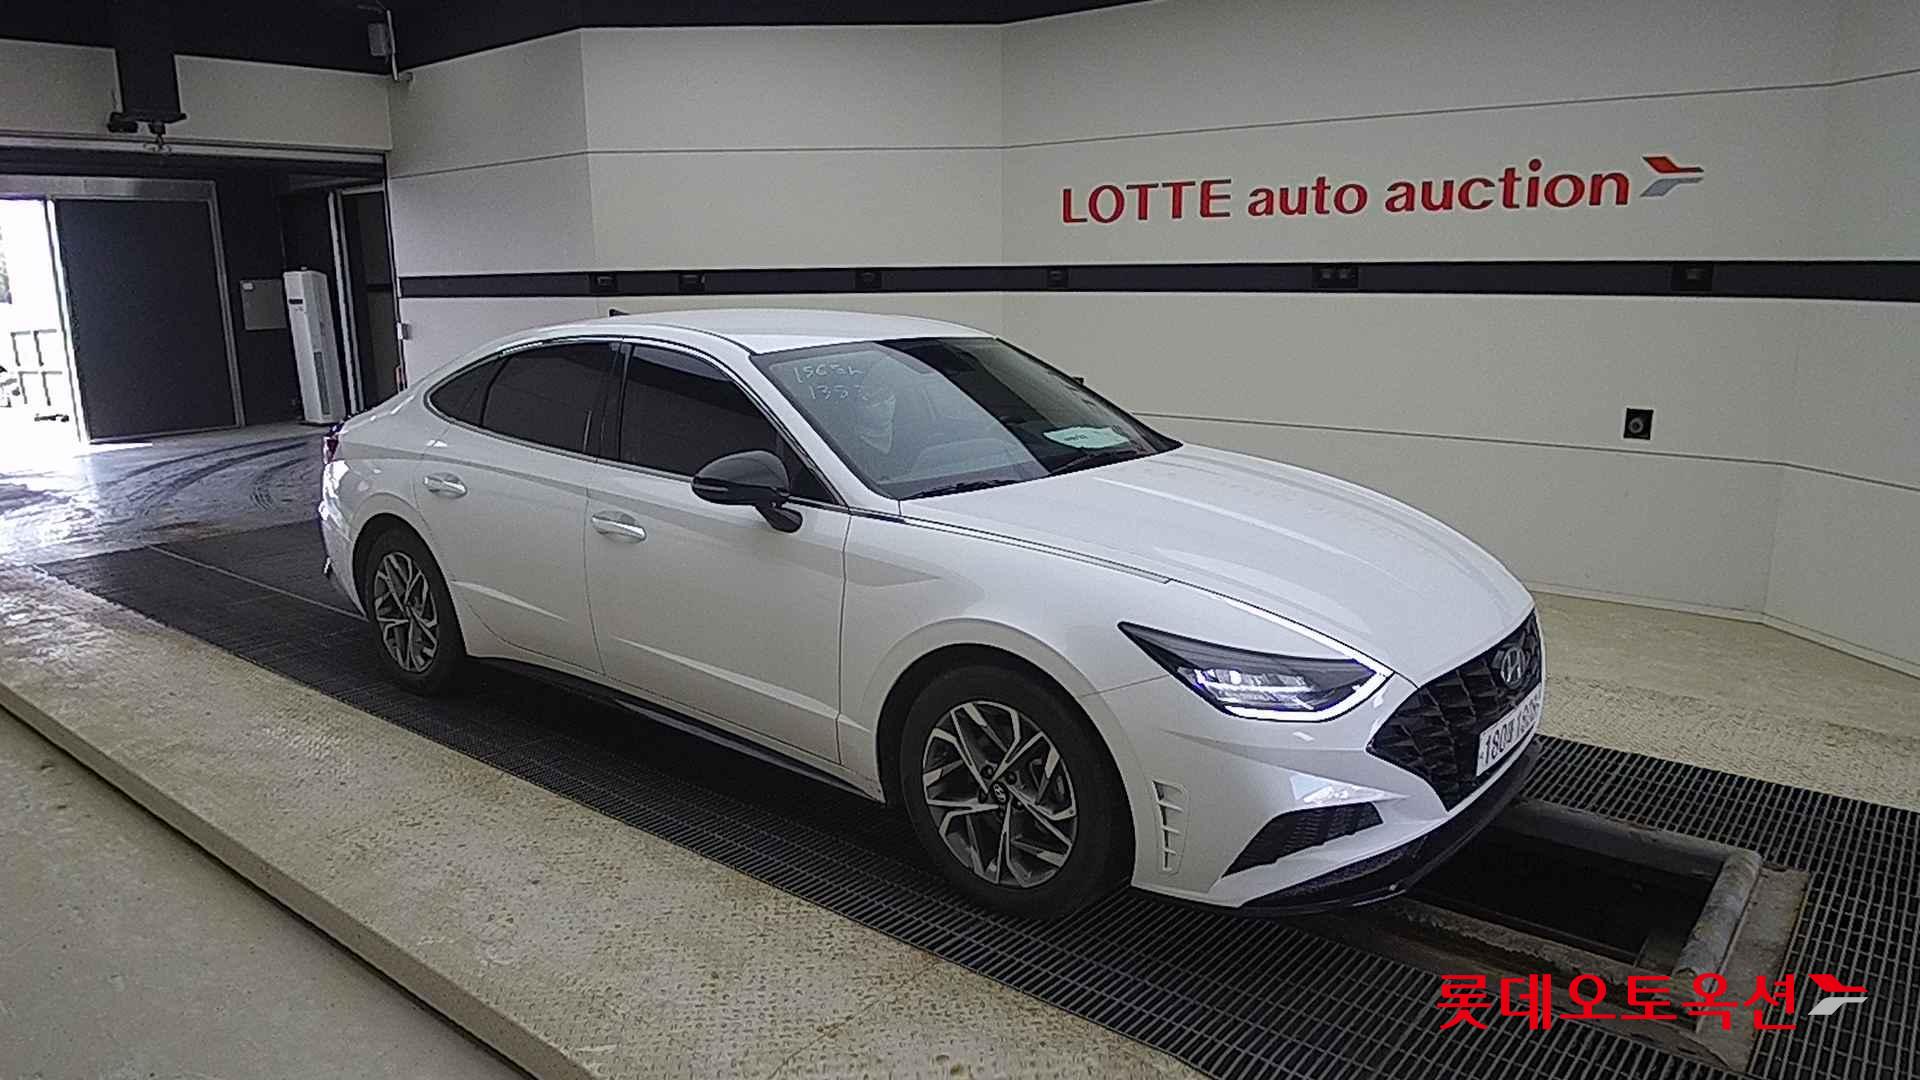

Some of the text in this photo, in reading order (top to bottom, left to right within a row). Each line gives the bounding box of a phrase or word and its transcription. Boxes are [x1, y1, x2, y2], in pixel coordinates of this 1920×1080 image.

[1062, 159, 1629, 224] LOTTE auto auction
